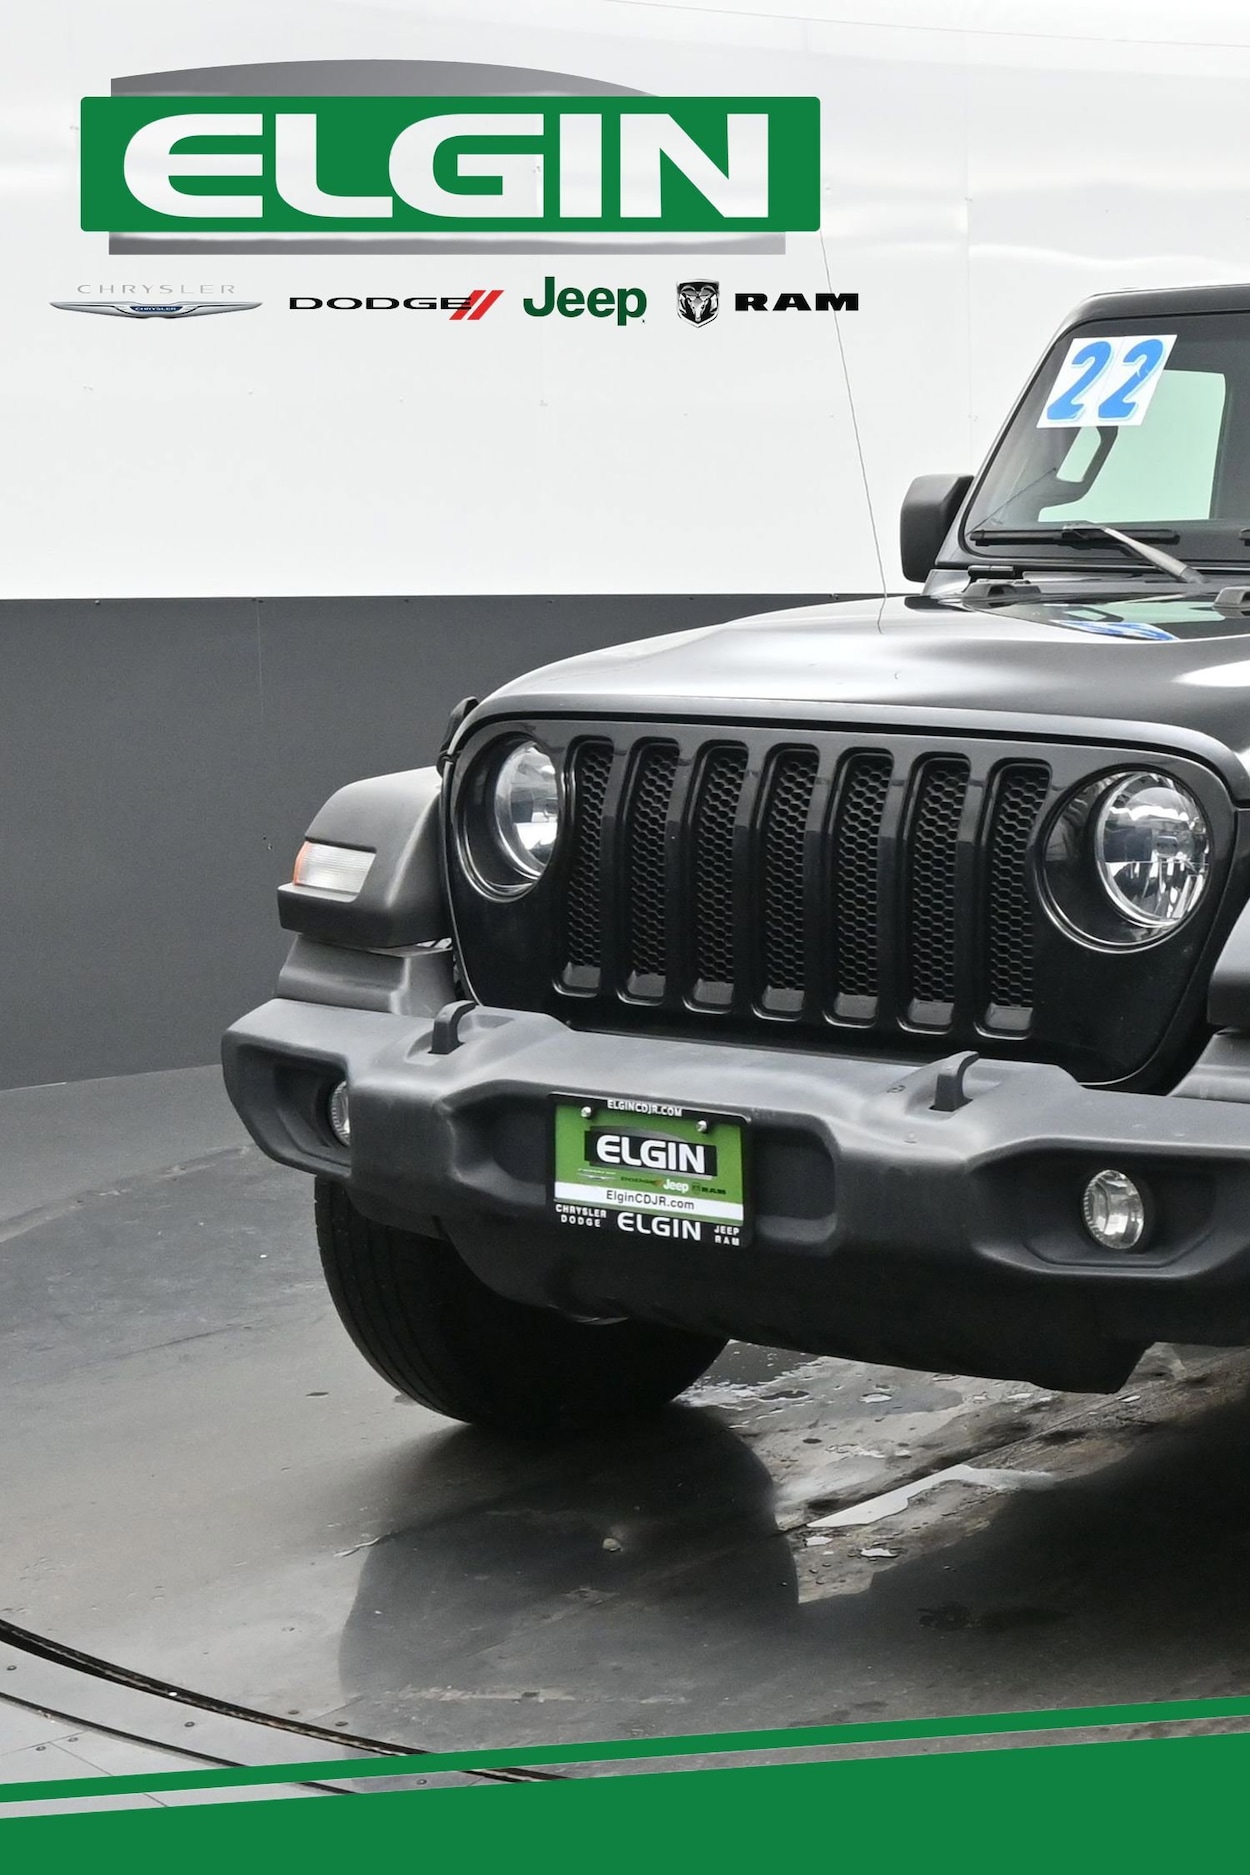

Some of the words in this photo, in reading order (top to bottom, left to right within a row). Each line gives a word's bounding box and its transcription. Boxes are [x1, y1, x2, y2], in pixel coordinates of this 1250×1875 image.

[1046, 338, 1166, 422] 22
[607, 1099, 683, 1117] ELGINCDJR.COM
[596, 1134, 706, 1174] ELGIN
[663, 1178, 690, 1194] Jeep
[606, 1189, 695, 1210] ElginCDJR.com
[555, 1203, 607, 1219] CHRYSLER
[560, 1214, 601, 1228] DODGE
[617, 1211, 701, 1241] ELGIN
[713, 1225, 740, 1236] JEEP
[714, 1235, 740, 1247] RAM
